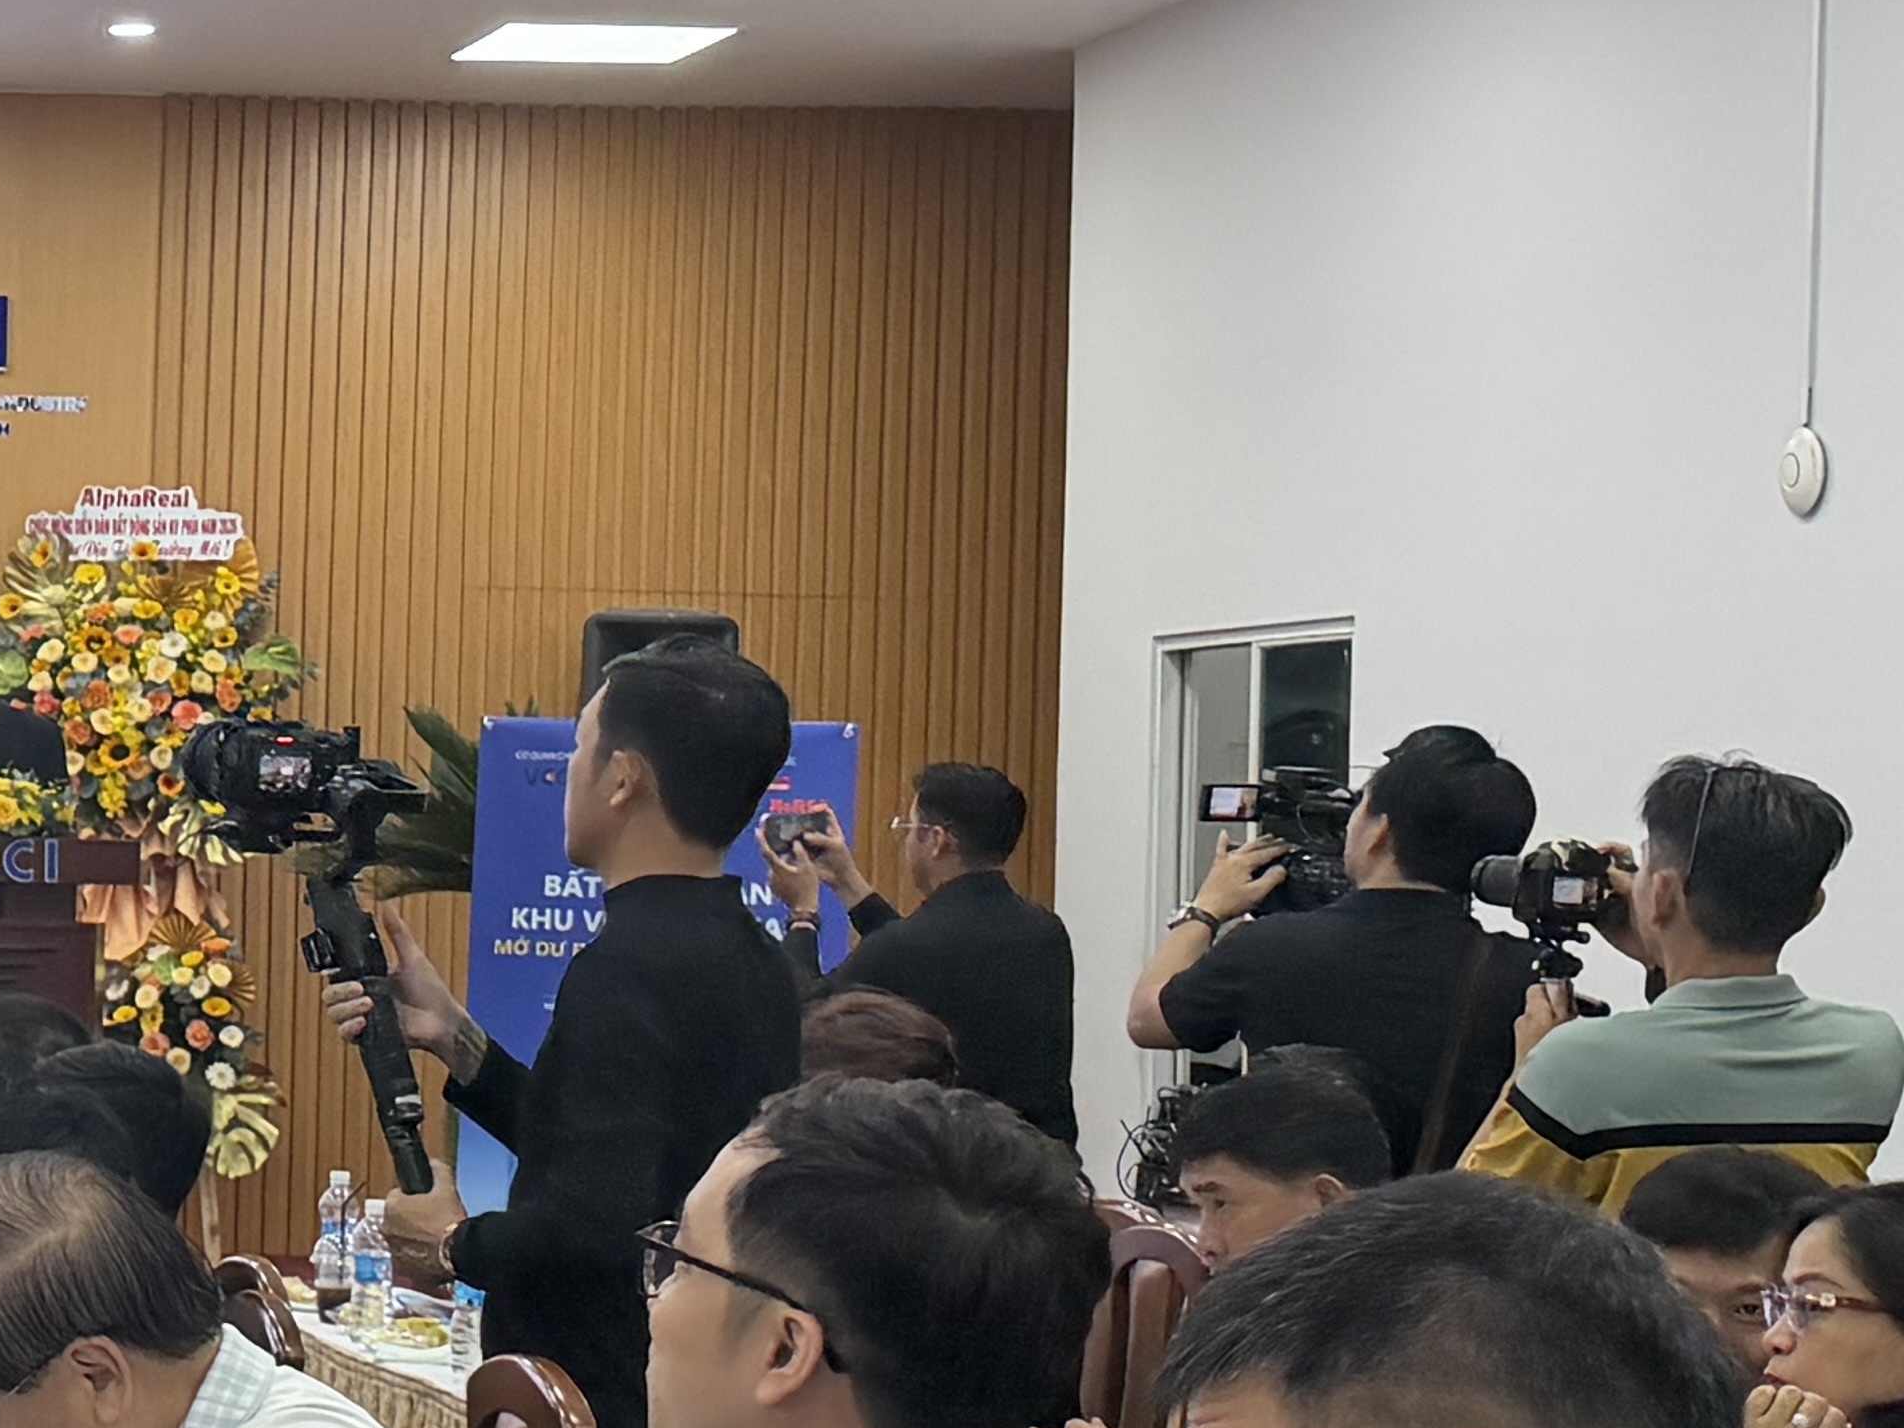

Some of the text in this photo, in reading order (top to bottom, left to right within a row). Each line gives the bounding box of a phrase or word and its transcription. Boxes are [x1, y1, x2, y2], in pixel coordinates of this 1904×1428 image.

[81, 488, 190, 510] AlphaReal
[544, 867, 603, 898] BẤT
[511, 907, 573, 932] KHU
[494, 935, 530, 956] MỞ
[535, 939, 566, 957] DƯ
